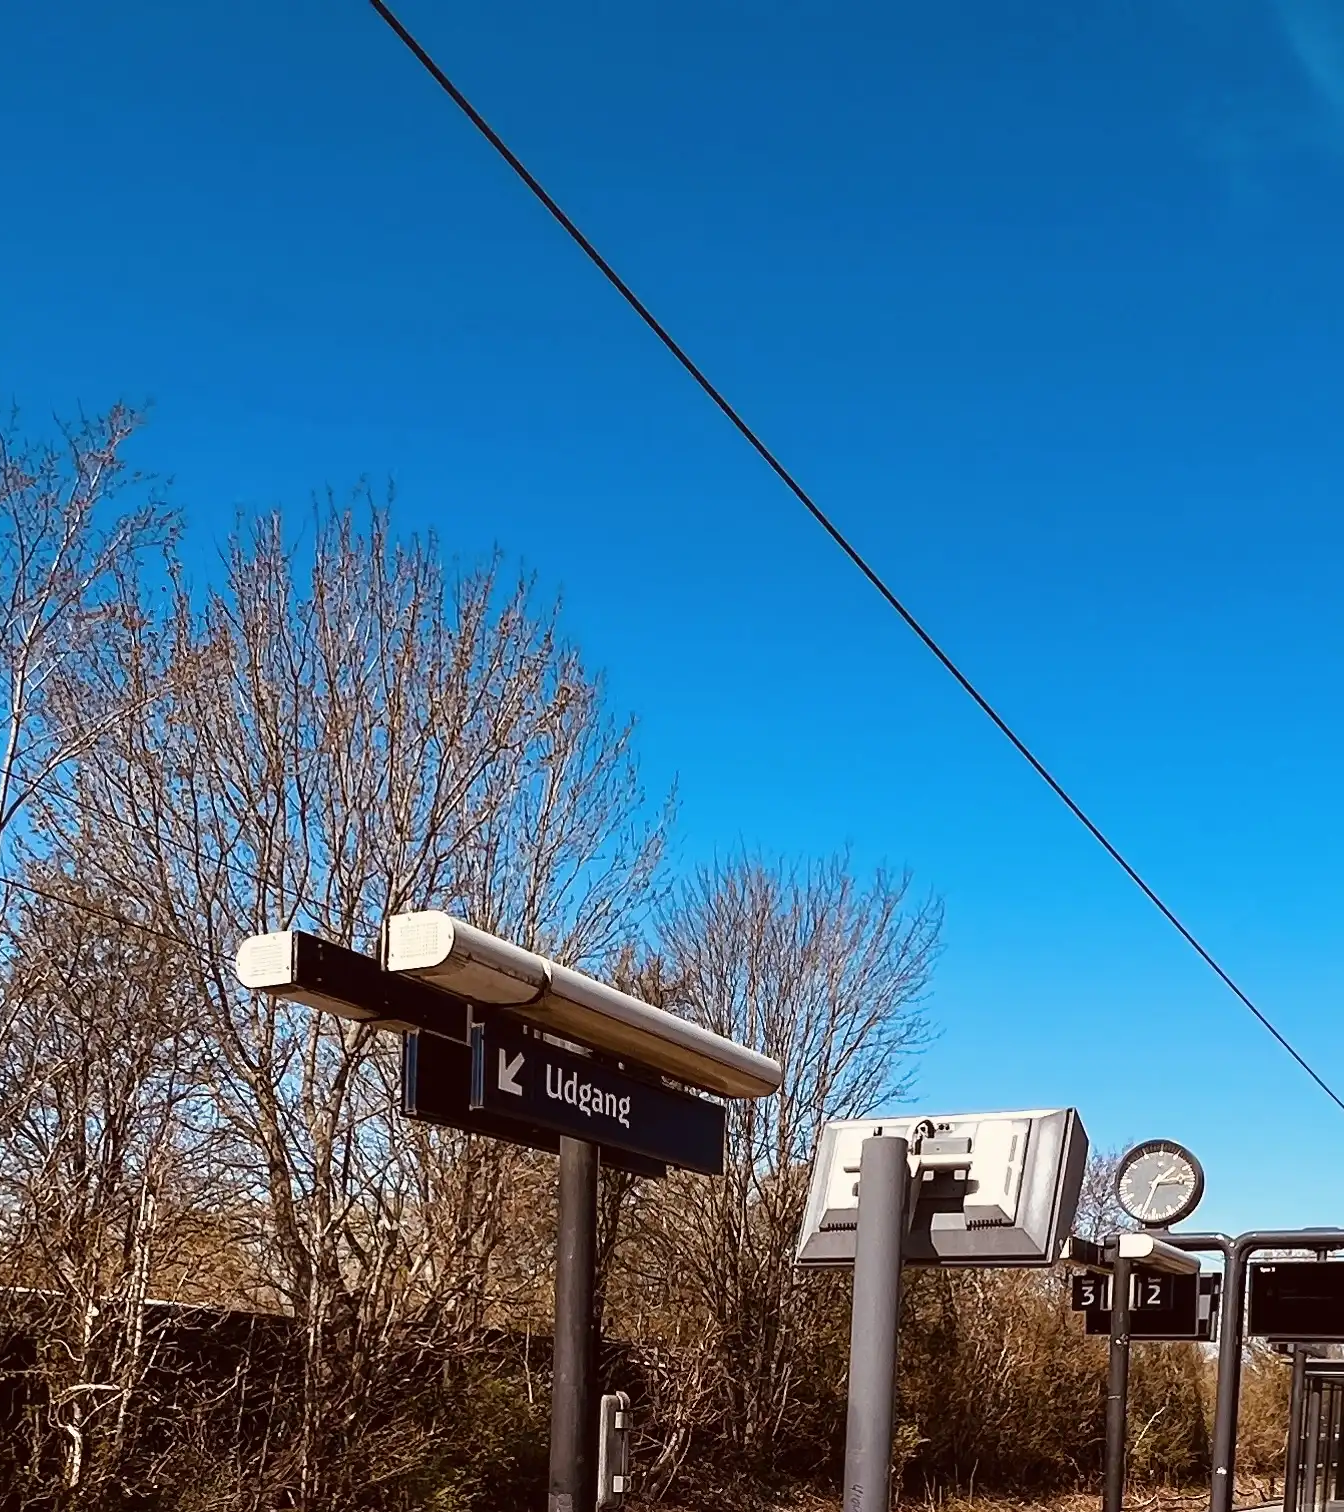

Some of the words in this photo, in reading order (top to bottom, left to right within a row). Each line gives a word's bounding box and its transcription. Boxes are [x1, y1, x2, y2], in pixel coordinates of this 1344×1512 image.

[545, 1063, 631, 1129] Udgang
[1081, 1286, 1095, 1306] 3
[1147, 1285, 1161, 1305] 2
